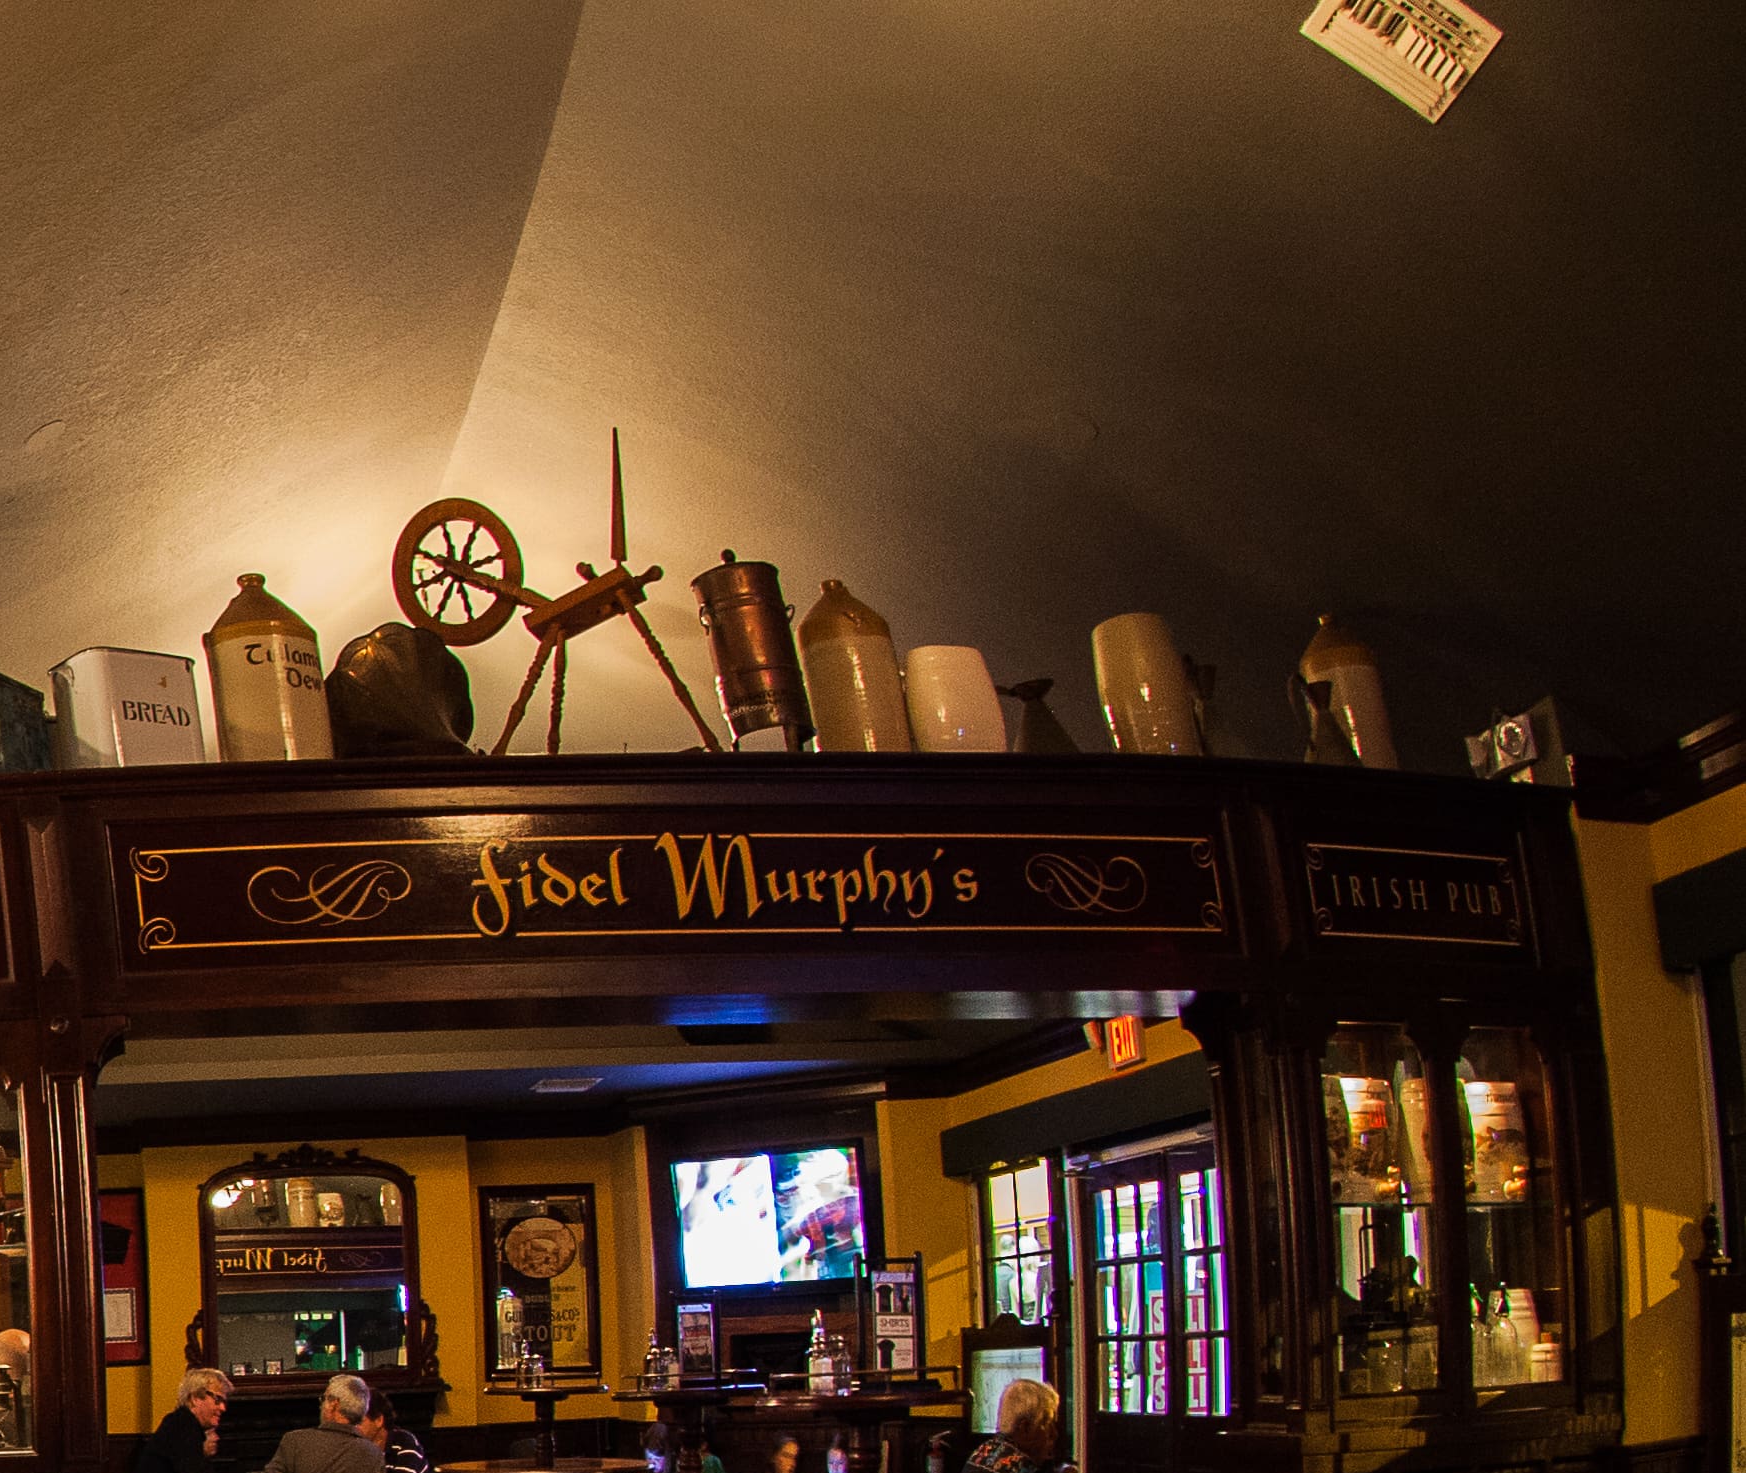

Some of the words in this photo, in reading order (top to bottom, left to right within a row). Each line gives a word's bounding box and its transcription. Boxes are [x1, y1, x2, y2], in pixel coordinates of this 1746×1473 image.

[121, 699, 191, 728] BREAD
[654, 831, 979, 925] Murphy's
[1332, 873, 1429, 911] IRISH
[1447, 880, 1502, 916] PUB
[1111, 1016, 1136, 1063] EXIT
[513, 1324, 576, 1342] STOUT
